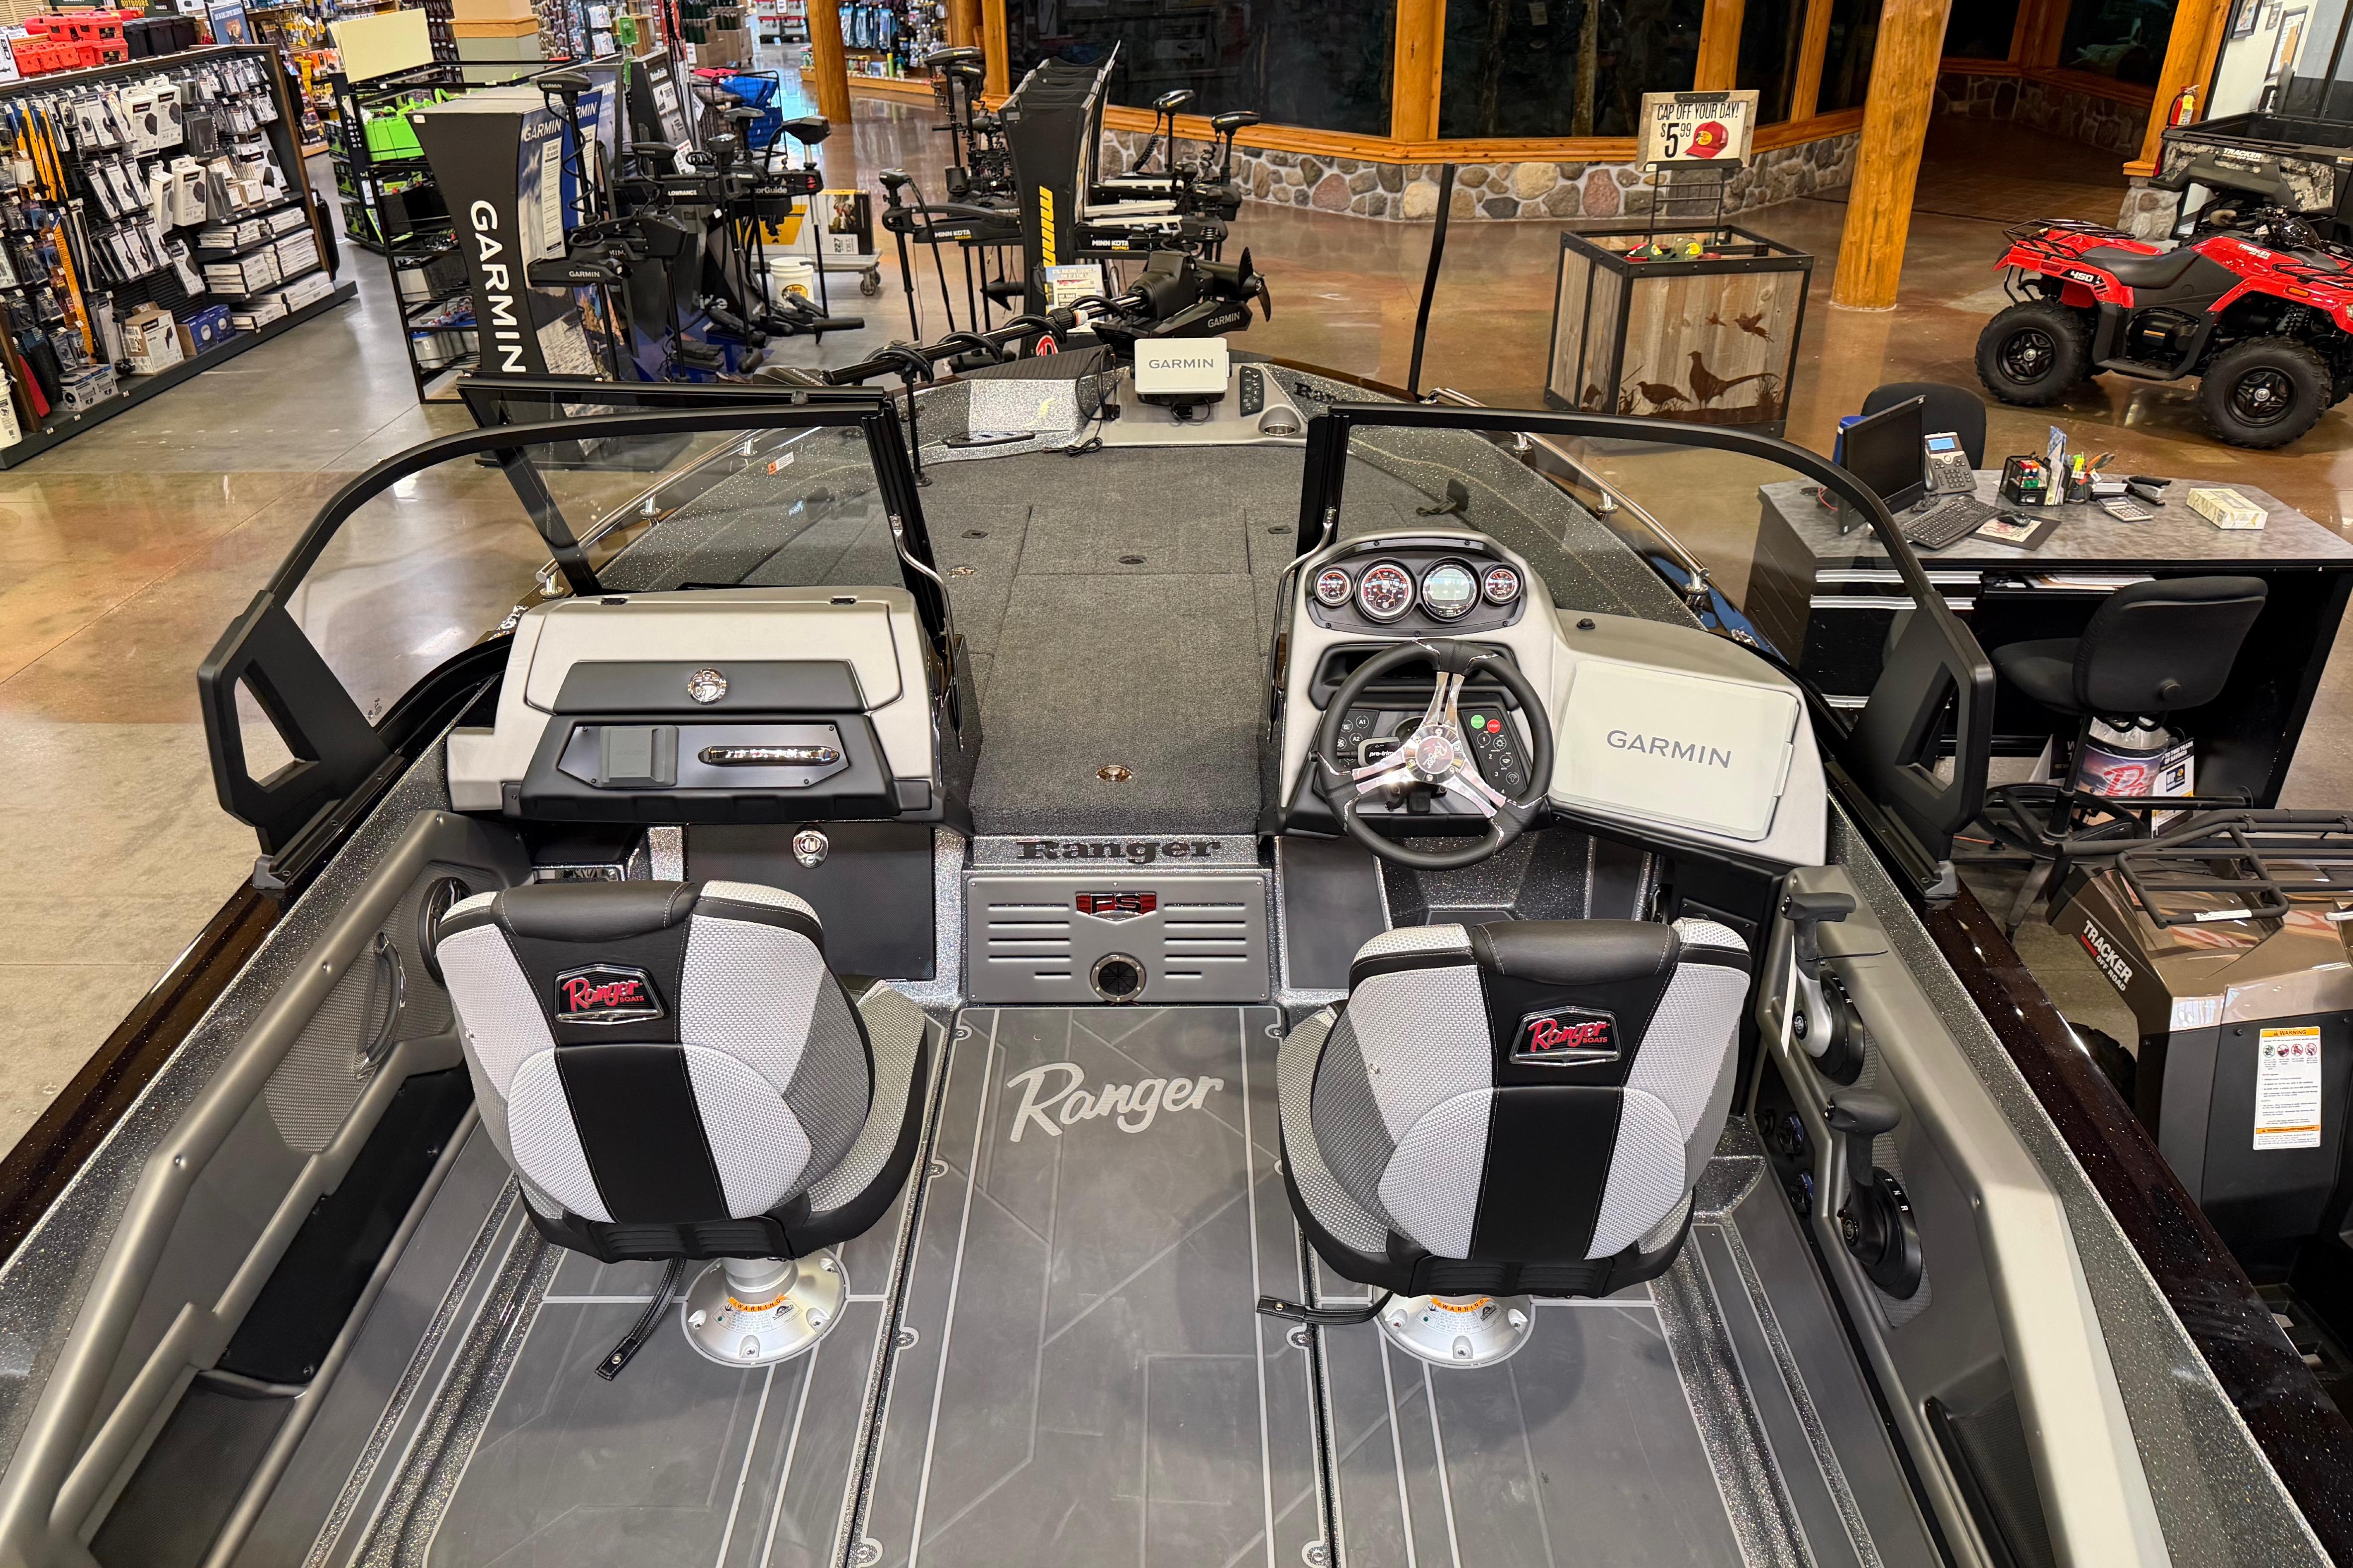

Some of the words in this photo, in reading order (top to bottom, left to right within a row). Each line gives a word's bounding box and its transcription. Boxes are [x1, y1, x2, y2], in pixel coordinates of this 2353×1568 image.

[566, 101, 597, 120] RMIN
[1657, 104, 1675, 120] CAP
[1677, 103, 1693, 120] OFF
[1695, 103, 1717, 119] YOUR
[1719, 102, 1739, 118] DAY!
[523, 118, 562, 142] GARMIN
[2224, 148, 2262, 159] TRACKER
[471, 200, 526, 372] GARMIN
[2070, 271, 2094, 283] 450
[1208, 311, 1240, 328] GARMIN
[1148, 359, 1214, 369] GARMIN
[789, 368, 823, 386] GARMIN
[1607, 730, 1732, 768] GARMIN
[1016, 840, 1221, 864] Ranger
[2083, 919, 2133, 984] TRACKER
[2096, 955, 2109, 970] OFF
[2107, 969, 2127, 991] ROAD
[561, 977, 639, 1012] Ranger
[1528, 1017, 1607, 1053] Ranger
[1007, 1062, 1225, 1143] Ranger
[738, 1298, 781, 1312] WARNING
[1443, 1299, 1484, 1312] WARNING
